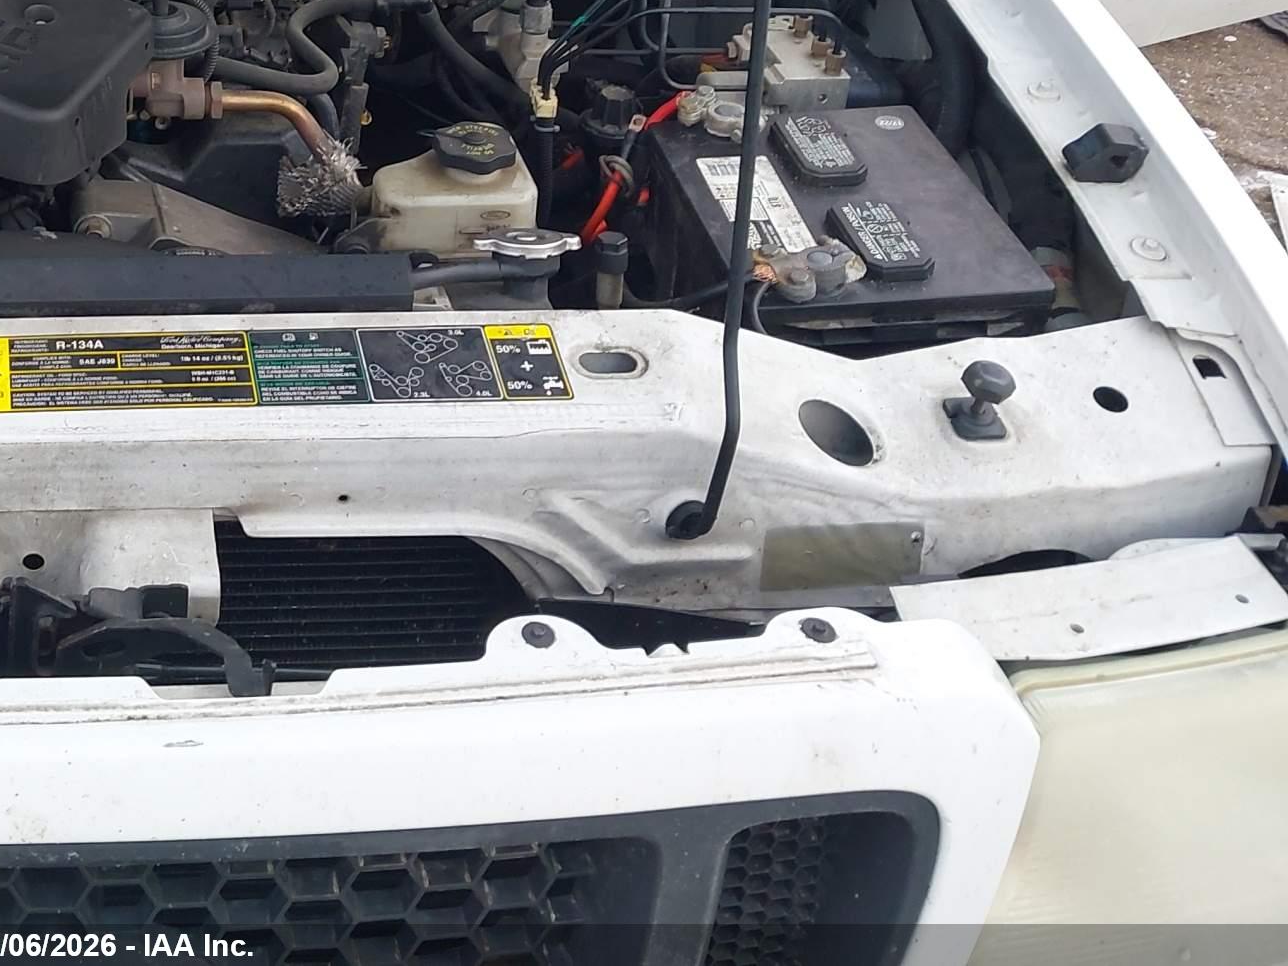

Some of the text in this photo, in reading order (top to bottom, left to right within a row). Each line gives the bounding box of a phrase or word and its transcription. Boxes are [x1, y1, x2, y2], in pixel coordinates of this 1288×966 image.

[56, 340, 104, 350] R-134A
[496, 345, 521, 354] 50%
[507, 381, 533, 390] 50%
